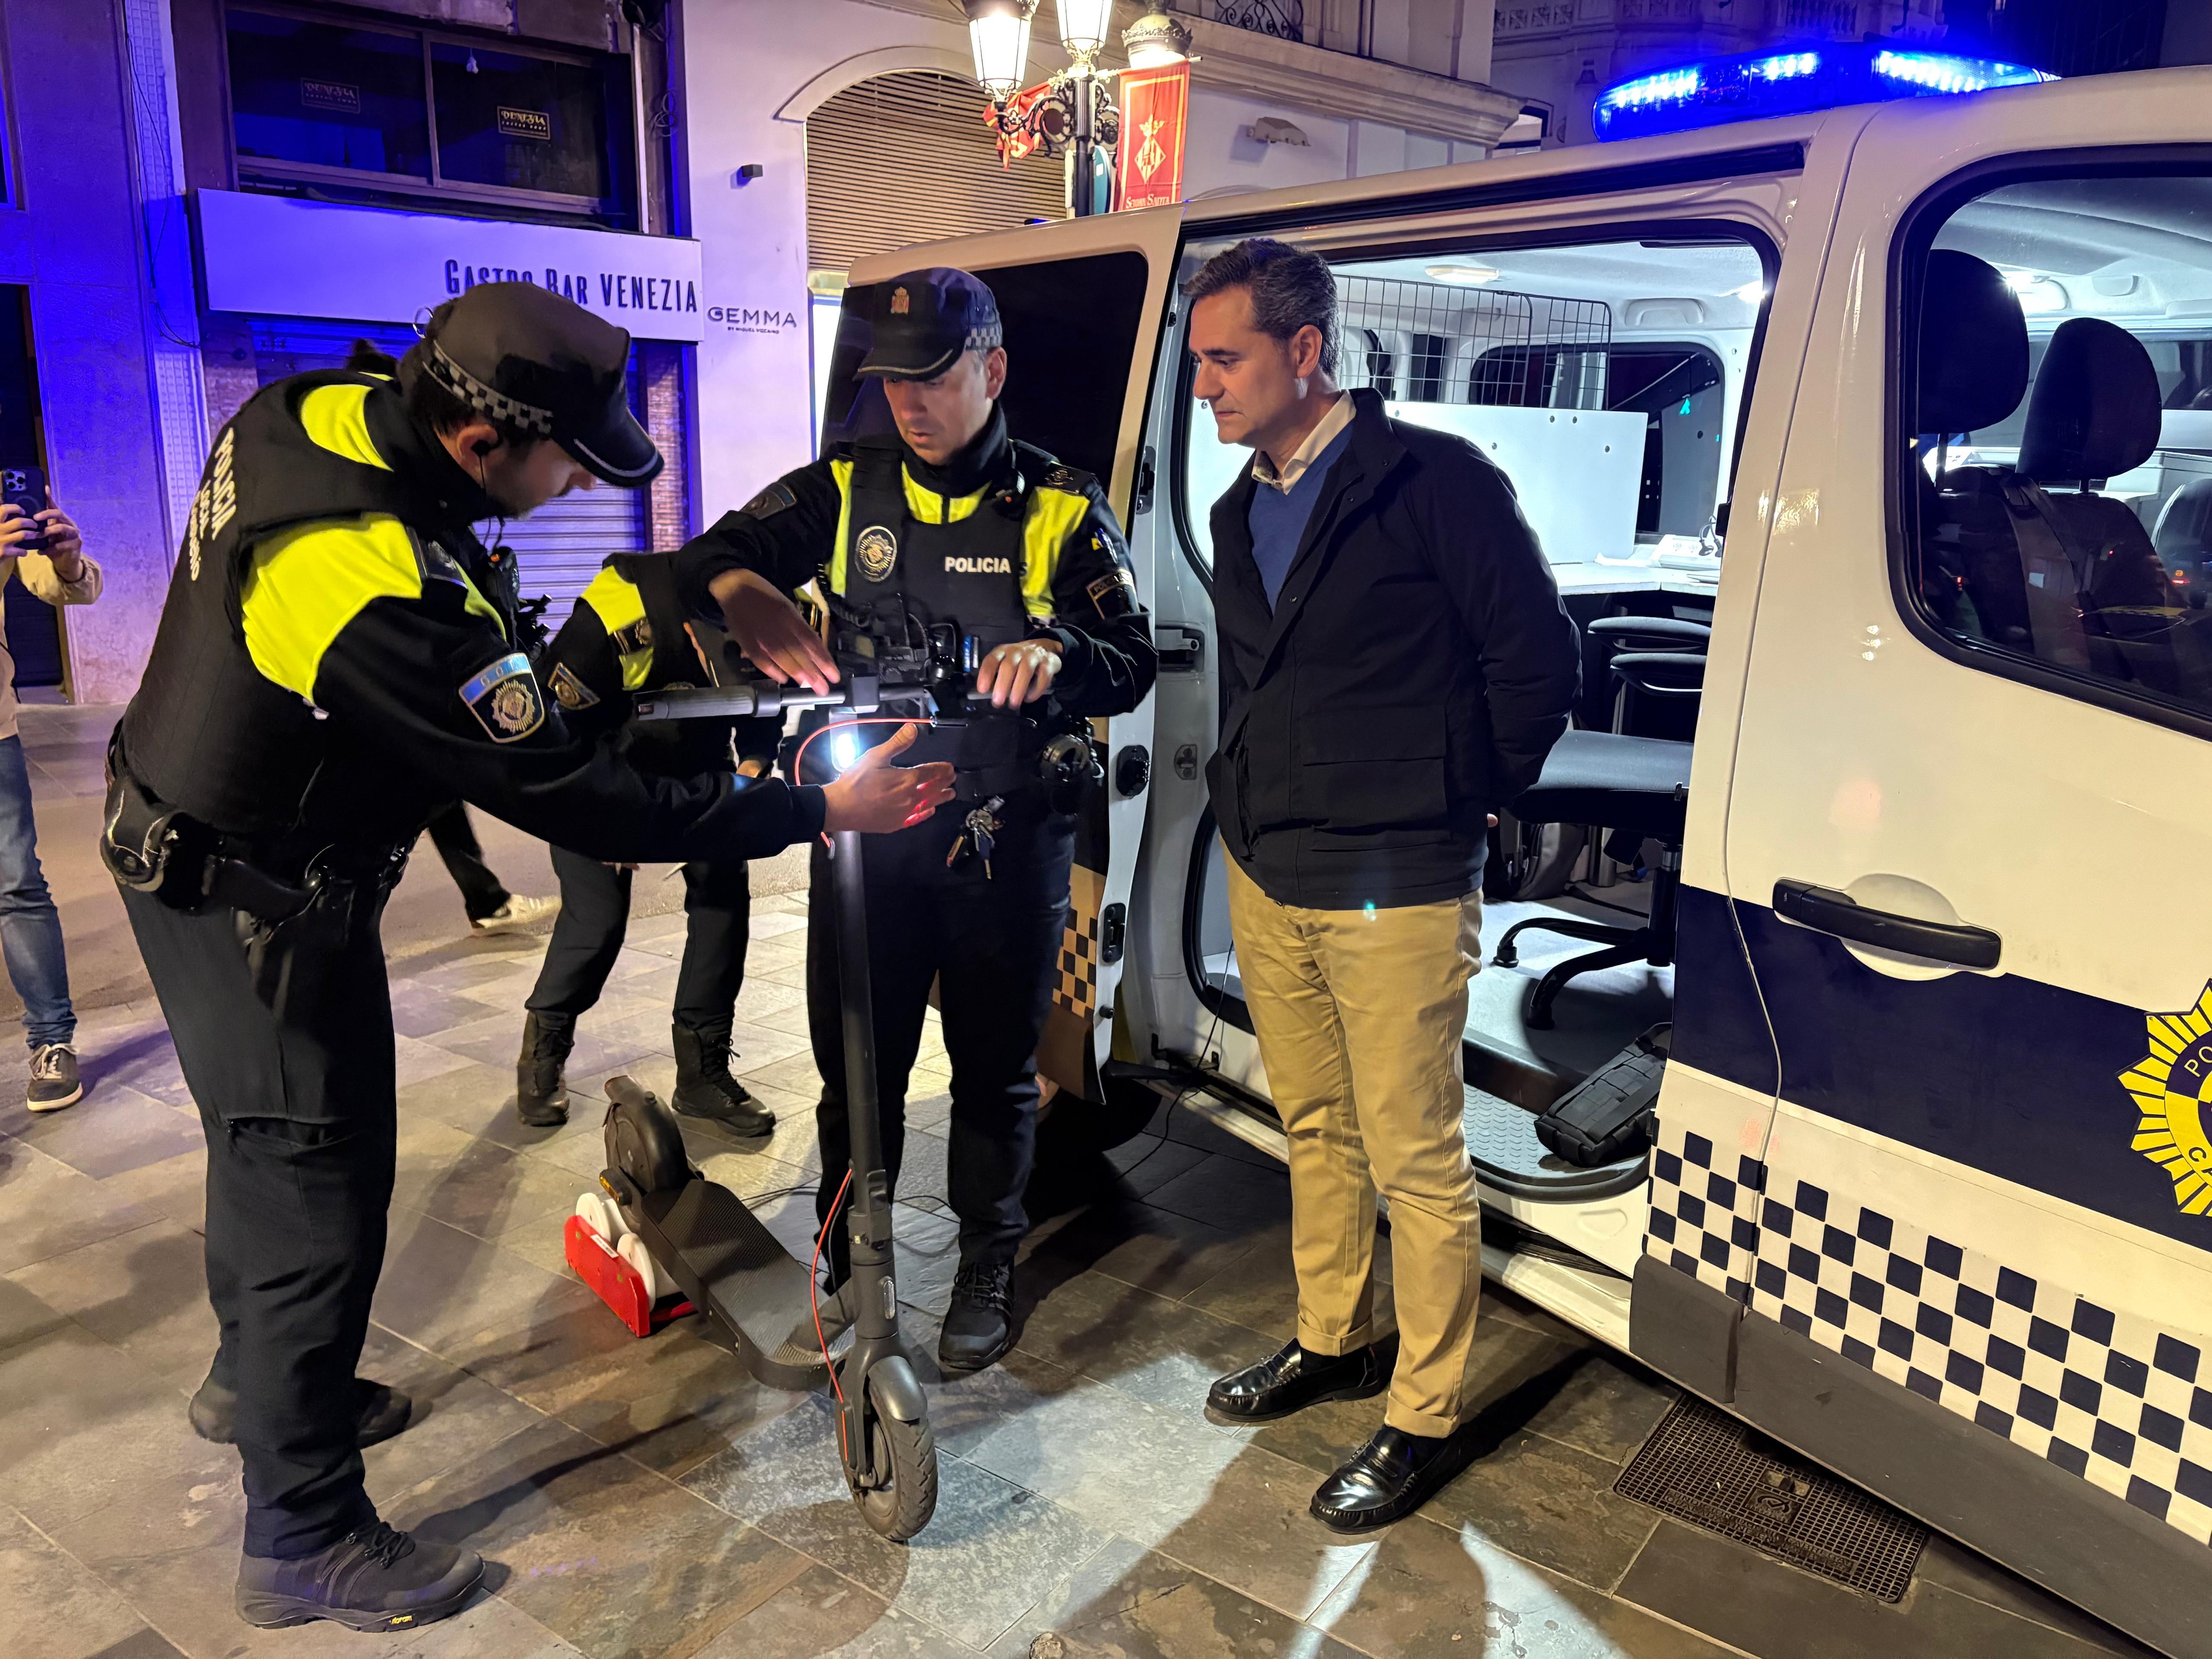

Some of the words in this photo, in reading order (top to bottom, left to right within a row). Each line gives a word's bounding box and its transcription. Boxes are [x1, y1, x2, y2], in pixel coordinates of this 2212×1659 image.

[601, 273, 697, 312] VENEZIA
[707, 306, 797, 327] GEMMA
[945, 556, 1011, 574] POLICIA
